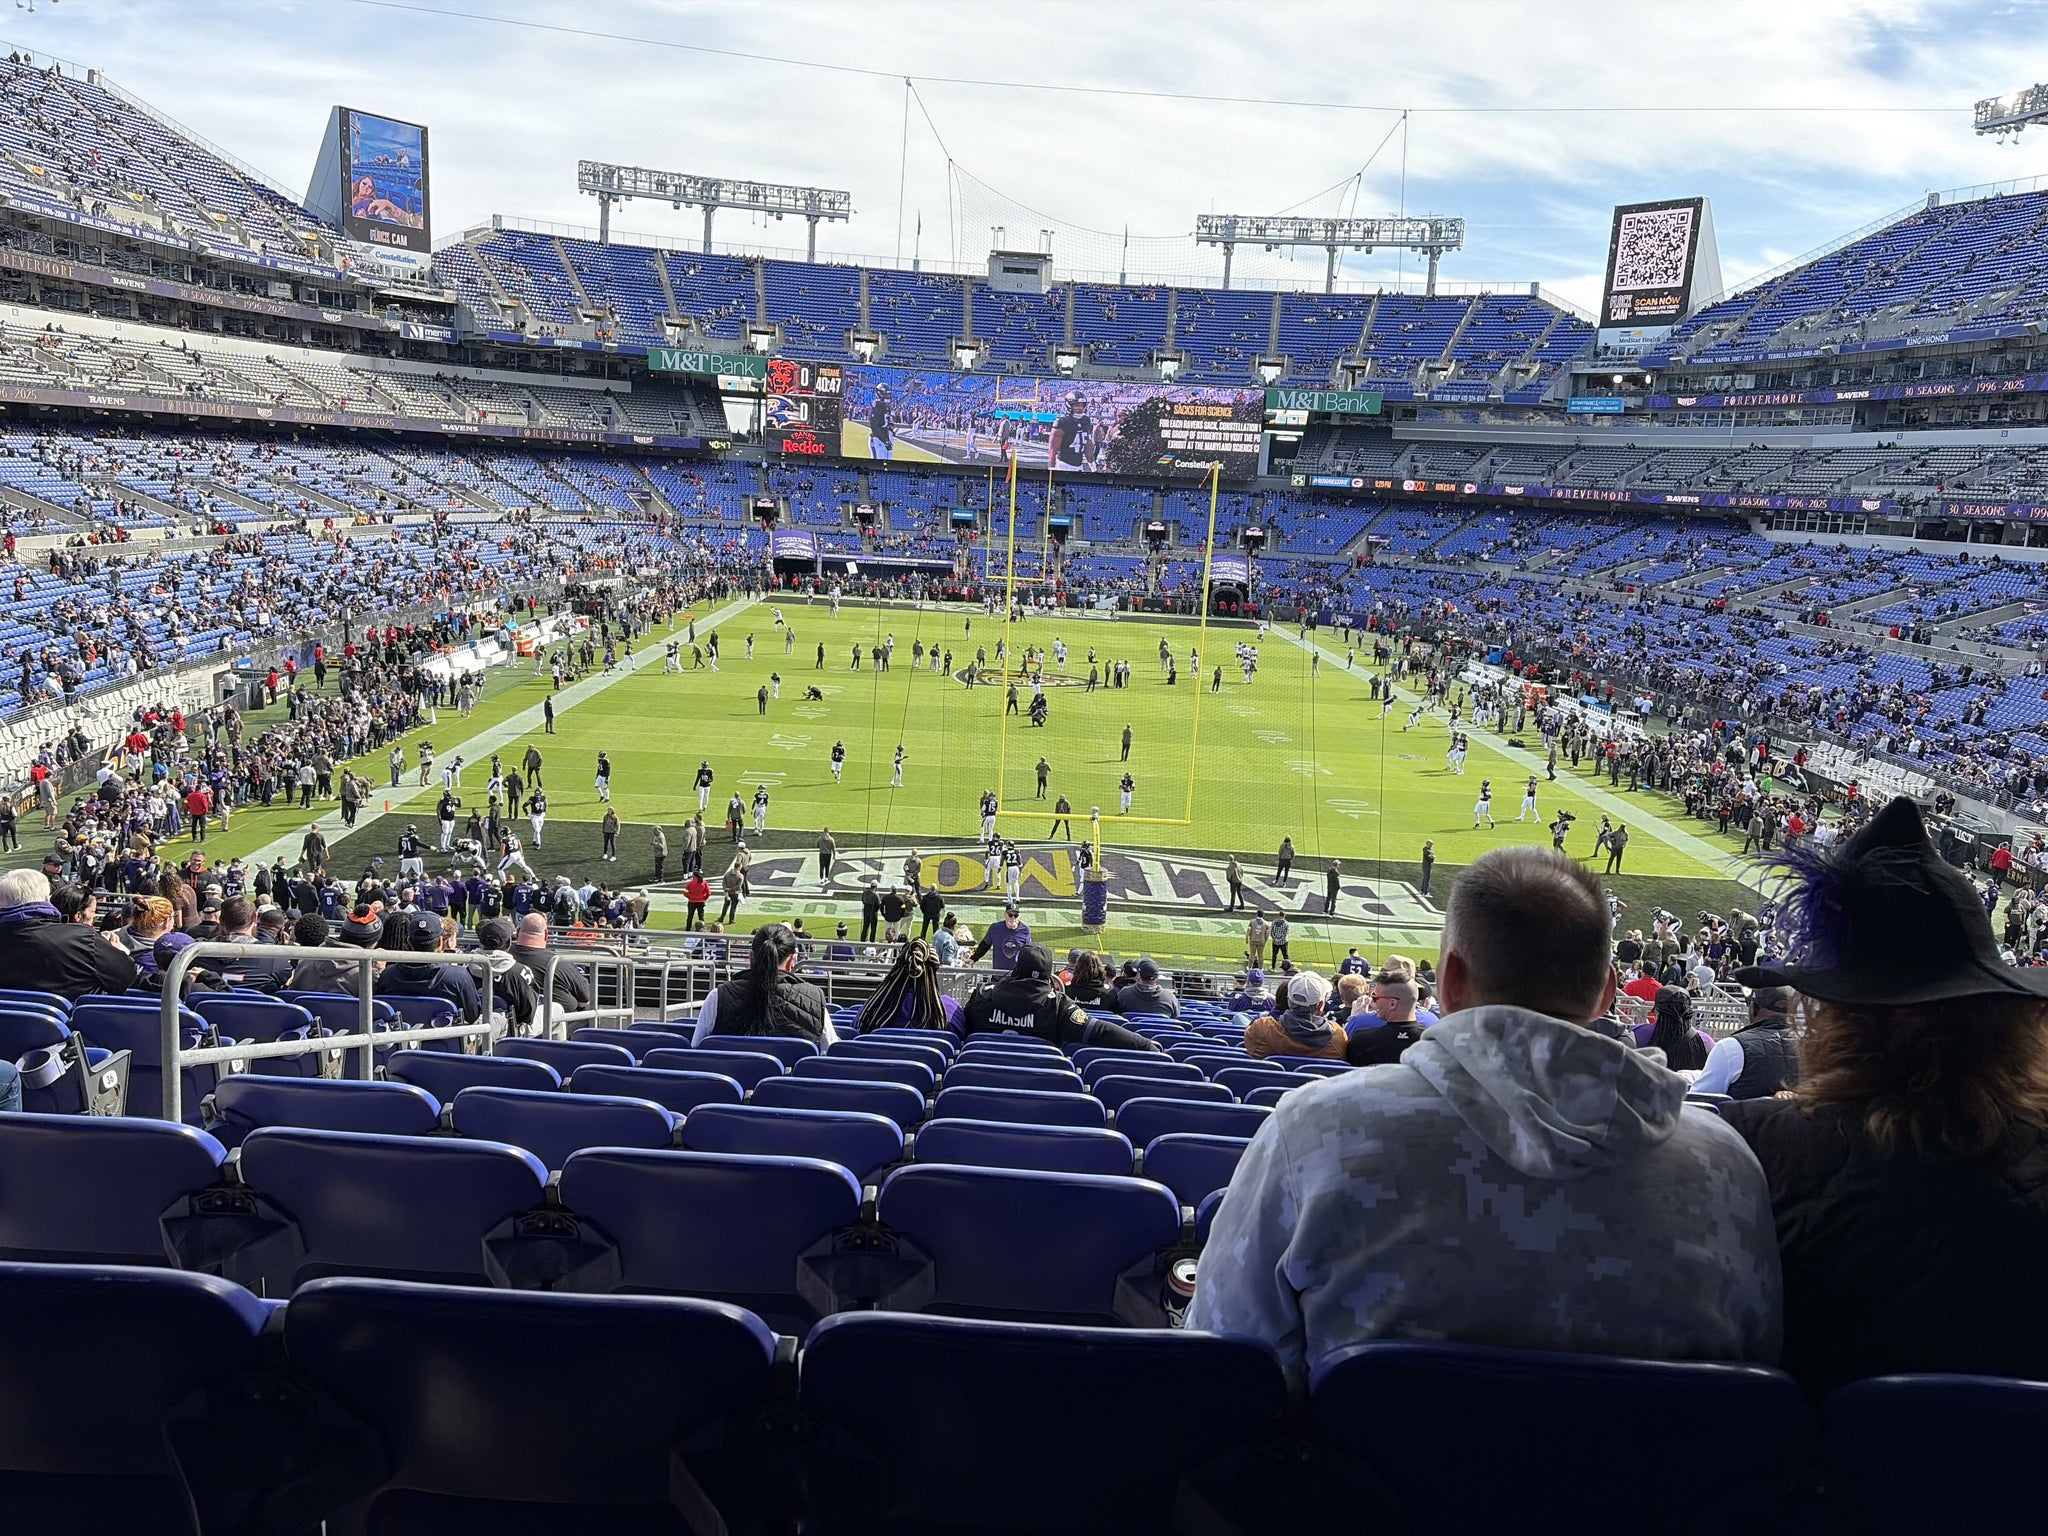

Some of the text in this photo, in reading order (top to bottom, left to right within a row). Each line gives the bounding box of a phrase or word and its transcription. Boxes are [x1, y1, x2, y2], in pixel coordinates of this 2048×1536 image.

[391, 233, 408, 247] CAM
[112, 276, 146, 290] RAVENS
[1635, 296, 1681, 306] SCAN NOW
[1610, 308, 1629, 320] CAM
[425, 328, 452, 339] merritt
[1906, 335, 1950, 346] RING HONOR
[1691, 356, 1713, 364] MARSHAL
[1714, 356, 1731, 364] YANDA
[1768, 352, 1787, 360] TERRELL
[1787, 351, 1803, 359] SUGGS
[660, 350, 755, 376] M&T Bank
[800, 367, 809, 387] 0
[815, 377, 841, 393] 40:47
[1904, 387, 1914, 397] 30
[1917, 384, 1956, 396] SEASONS
[88, 395, 126, 406] RAVENS
[1836, 390, 1870, 400] RAVENS
[1277, 390, 1371, 413] M&T Bank
[800, 402, 808, 422] 0
[1173, 404, 1234, 417] SACKS FOR SCIENCE
[302, 413, 335, 424] SEASONS
[1159, 419, 1169, 428] FOR
[1169, 419, 1183, 428] EACH
[440, 422, 479, 433] RAVENS
[1189, 431, 1197, 439] OF
[1243, 433, 1253, 442] THE
[709, 440, 731, 450] 40:47
[782, 439, 825, 454] RedHot
[1195, 441, 1204, 450] THE
[1232, 443, 1253, 452] SCIENCE
[1665, 495, 1699, 503] RAVENS
[1728, 496, 1736, 505] 30
[1738, 496, 1771, 507] SEASONS
[1948, 502, 1960, 514] 30
[1963, 504, 2006, 517] SEASONS
[737, 769, 787, 786] 10
[401, 841, 411, 851] 91
[991, 845, 1001, 855] 26
[1006, 853, 1018, 863] 22
[766, 849, 1421, 926] BALTMORE
[326, 896, 333, 906] 8
[488, 896, 494, 906] 8
[521, 893, 527, 903] 3
[1126, 914, 1330, 940] TKES
[988, 1008, 1035, 1028] JACKSON
